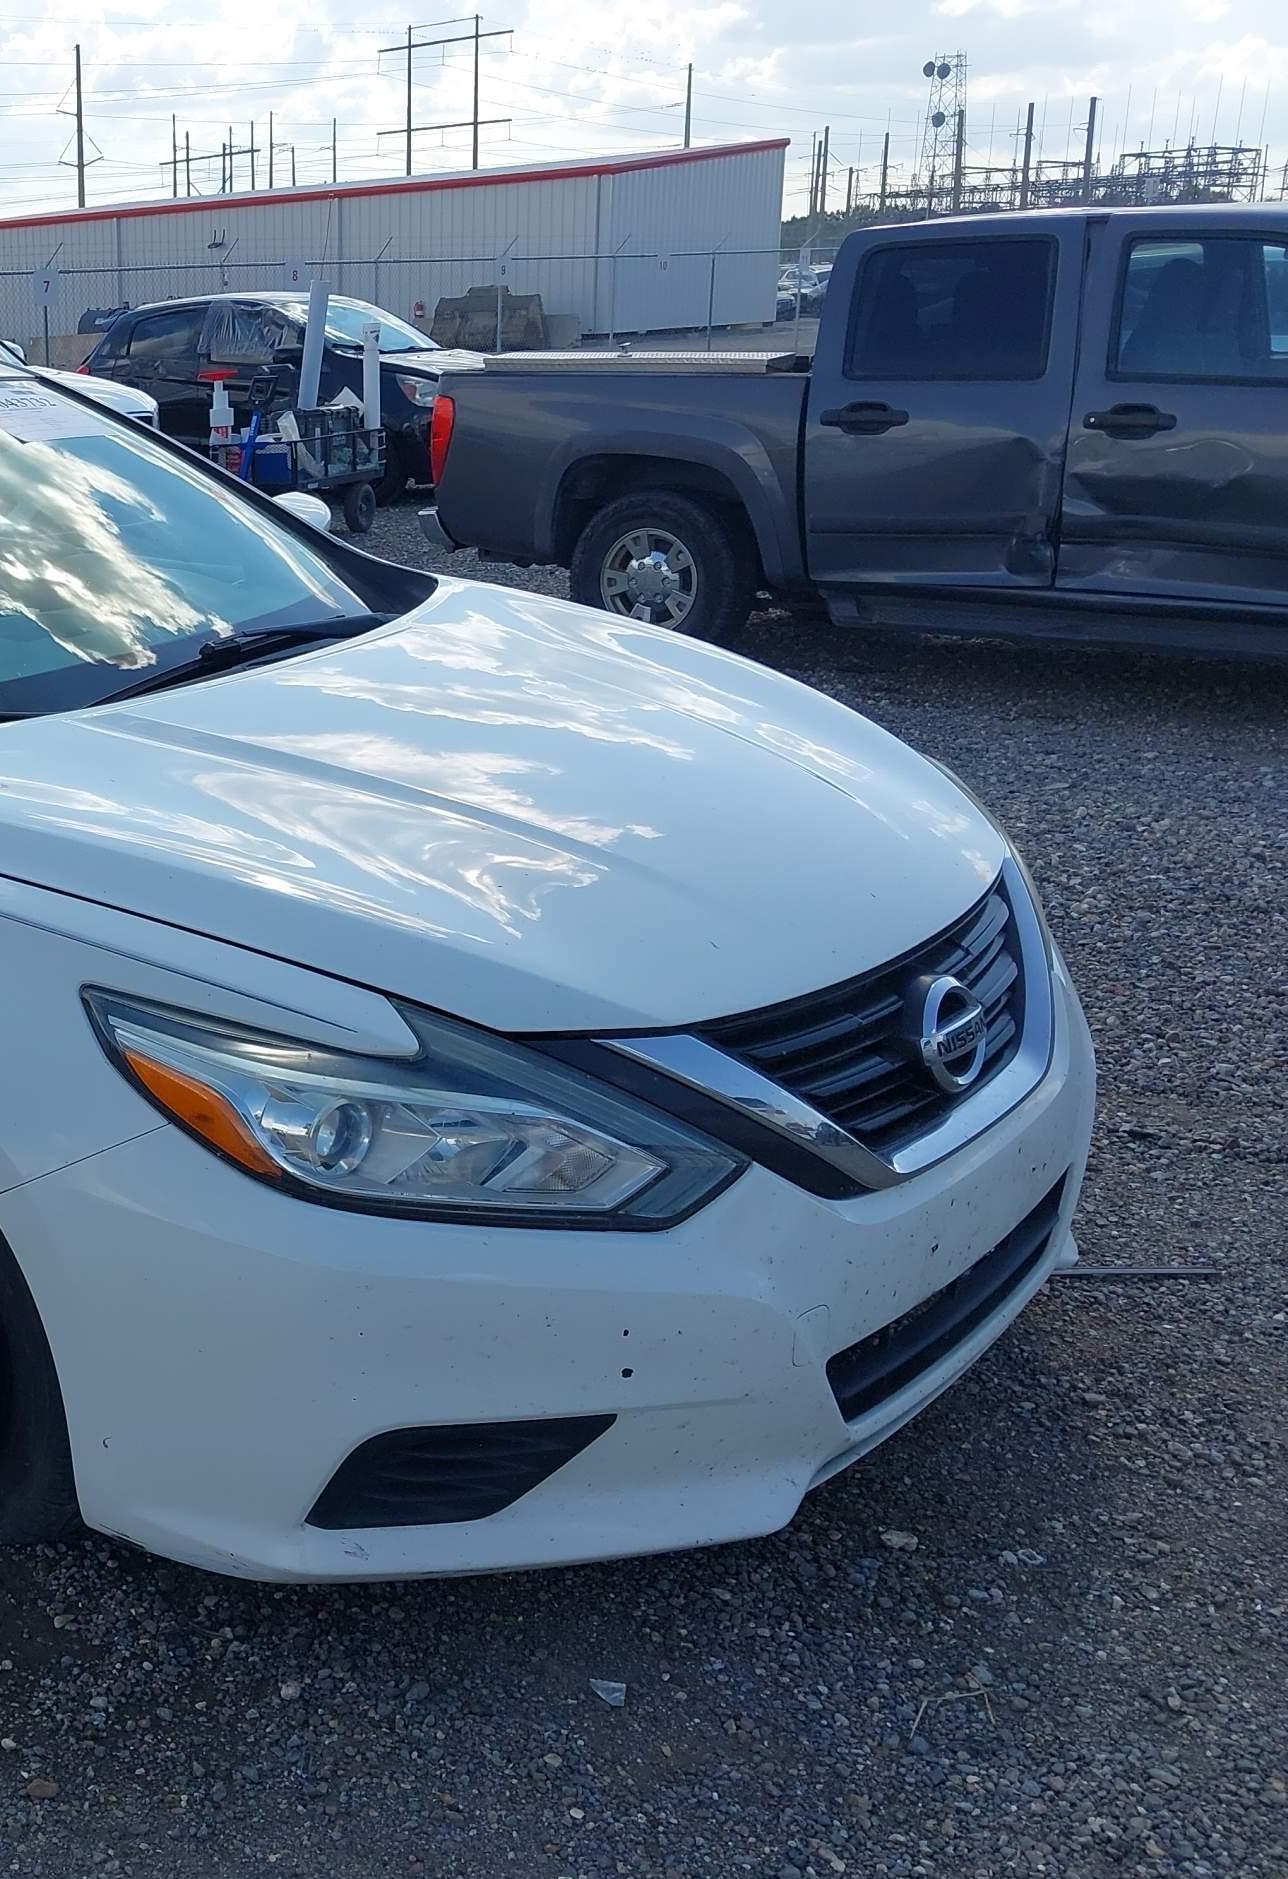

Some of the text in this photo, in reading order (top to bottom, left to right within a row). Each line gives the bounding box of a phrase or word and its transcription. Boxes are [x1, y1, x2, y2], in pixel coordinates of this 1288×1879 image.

[292, 270, 298, 281] 8
[43, 280, 50, 293] 7
[937, 1015, 987, 1057] NISSAN
